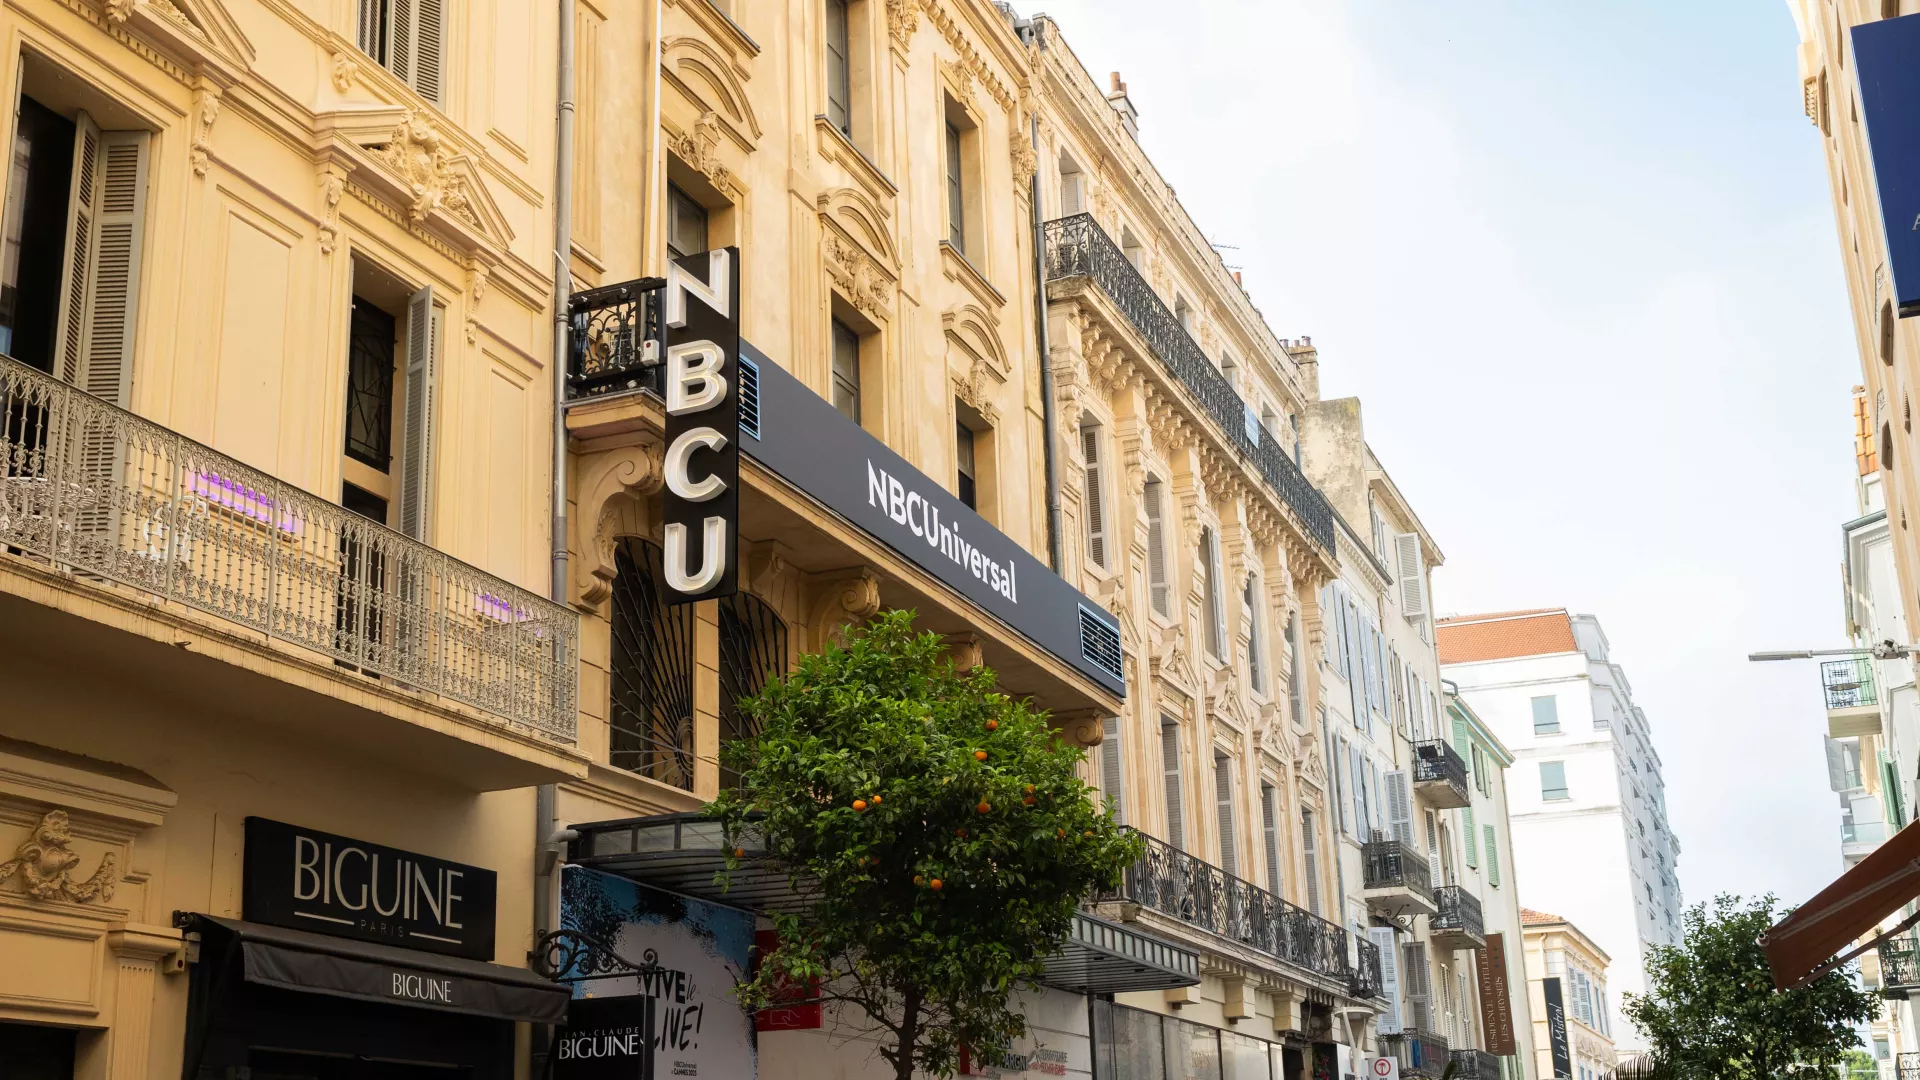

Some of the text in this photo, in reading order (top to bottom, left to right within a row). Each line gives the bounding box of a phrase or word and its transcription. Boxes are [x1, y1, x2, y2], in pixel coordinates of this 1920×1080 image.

[663, 248, 730, 595] NBCU
[867, 458, 1018, 605] NBCUniversal
[293, 835, 464, 929] BIGUINE
[360, 919, 405, 939] PARIS
[392, 972, 452, 1002] BIGUINE
[642, 966, 697, 1005] VIVE le
[1501, 1024, 1510, 1042] LES
[1549, 1002, 1564, 1042] Mistral
[559, 1034, 639, 1060] BIGUINE
[1558, 1045, 1568, 1060] Le
[674, 1068, 688, 1076] CANNES
